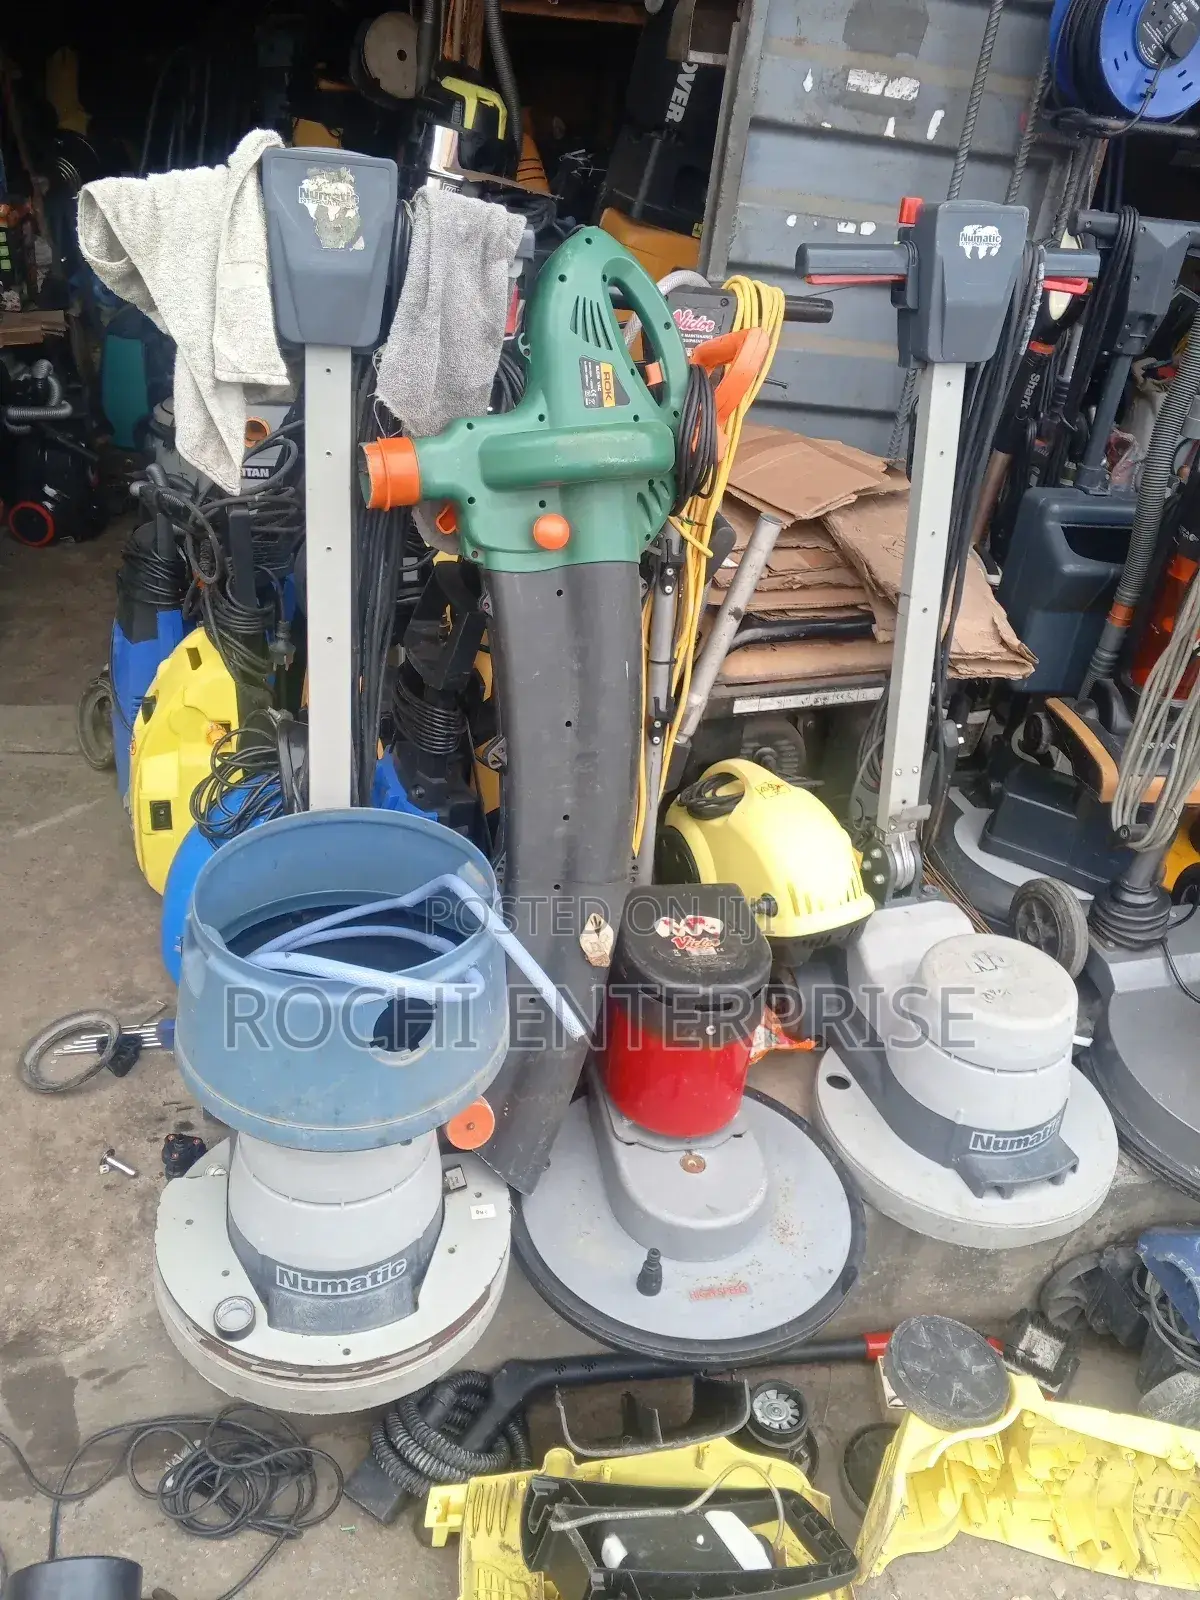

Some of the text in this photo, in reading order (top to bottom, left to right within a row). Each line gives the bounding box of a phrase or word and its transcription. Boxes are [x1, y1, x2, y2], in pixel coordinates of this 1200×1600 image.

[960, 231, 1002, 243] Numatic
[672, 308, 716, 332] Victor
[603, 371, 613, 401] ROK
[1020, 372, 1041, 410] Shark
[241, 467, 270, 478] ITAN
[276, 1258, 407, 1296] Numatic
